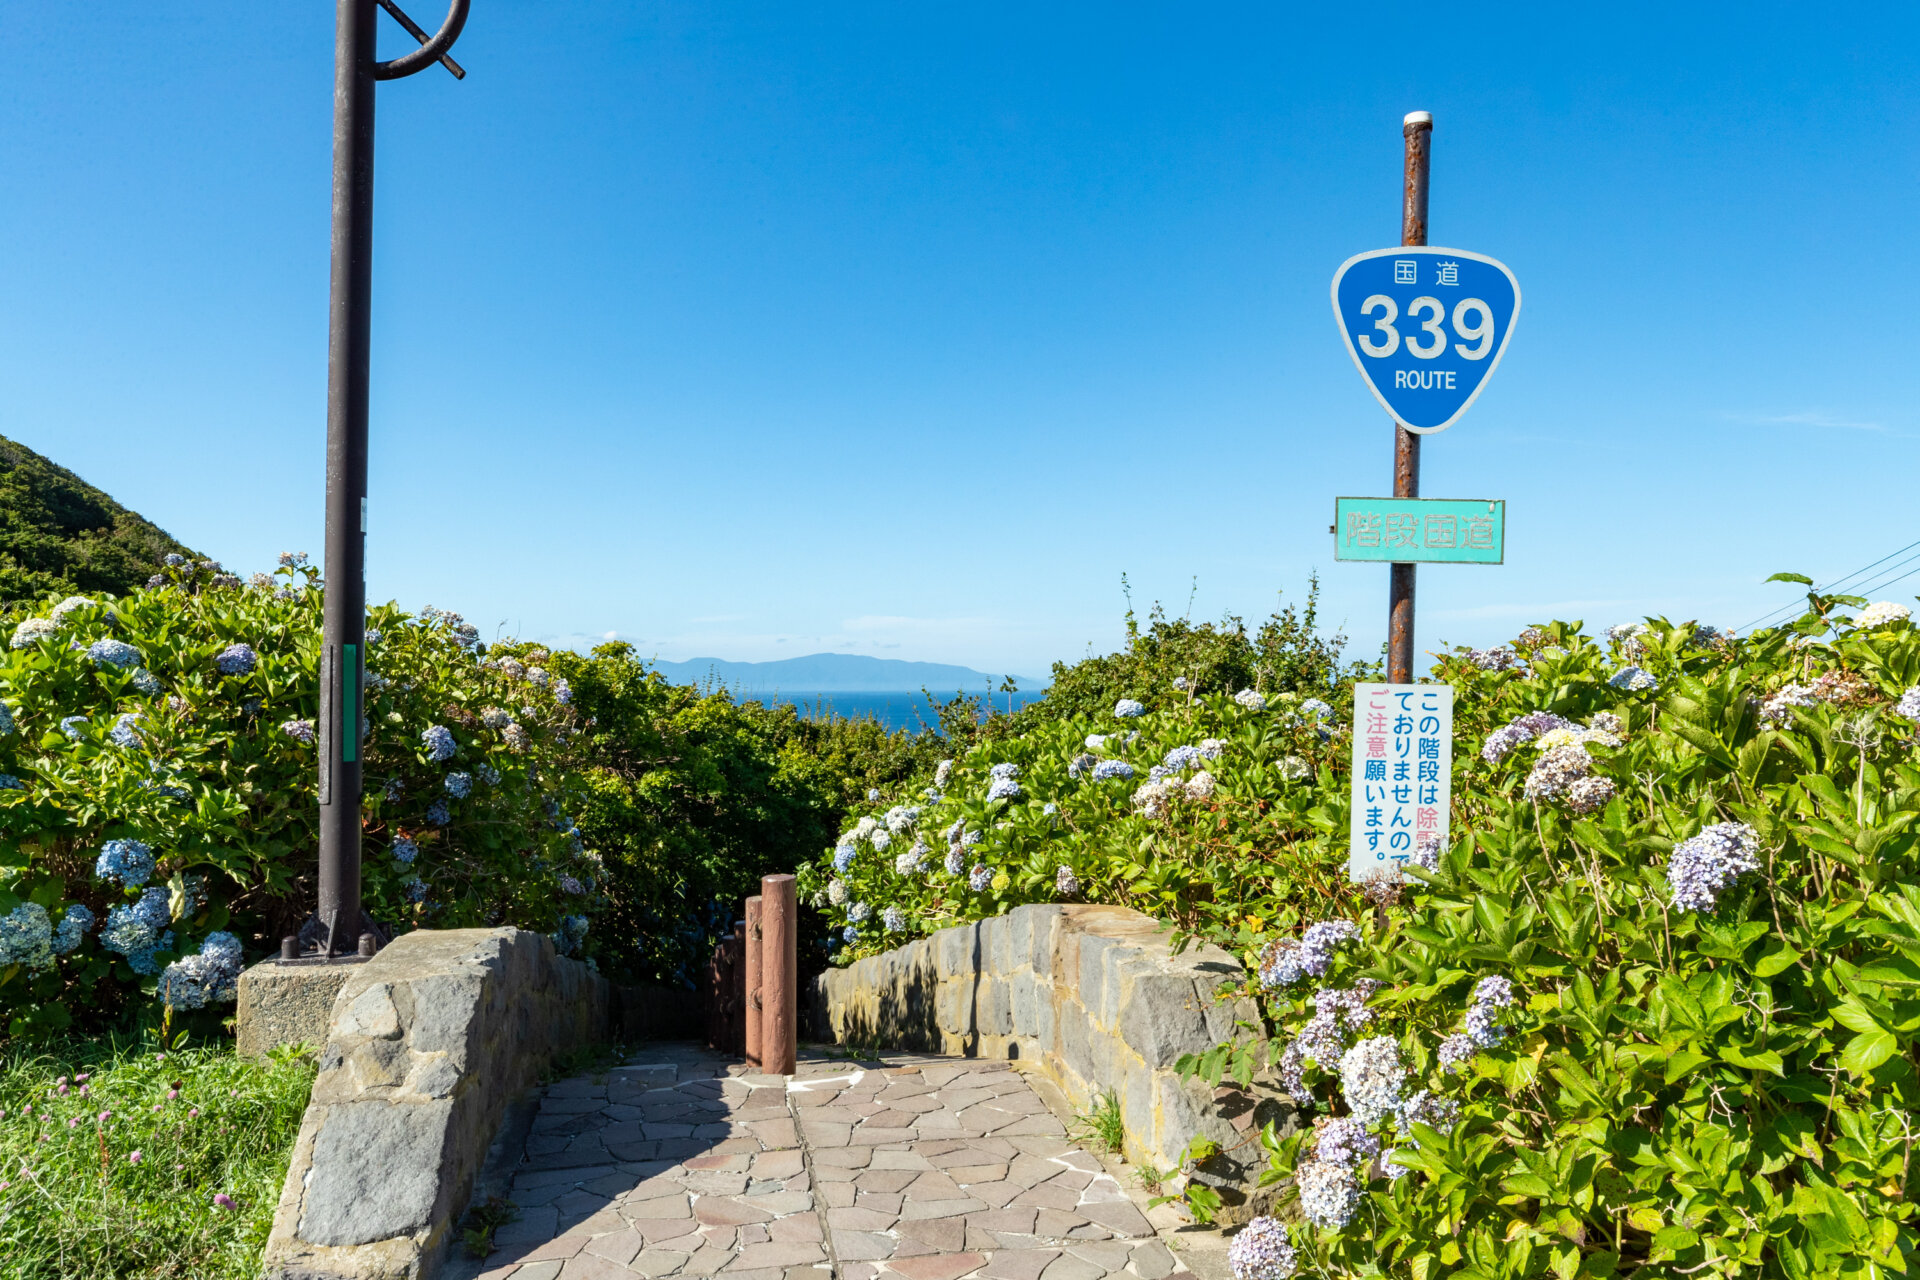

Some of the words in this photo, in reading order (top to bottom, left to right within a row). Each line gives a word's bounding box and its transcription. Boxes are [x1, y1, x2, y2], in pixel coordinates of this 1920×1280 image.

[1394, 260, 1460, 286] 国道
[1358, 294, 1495, 361] 339
[1395, 370, 1457, 390] ROUTE
[1346, 511, 1495, 550] 階段国道
[1364, 688, 1390, 861] ご注意願います。
